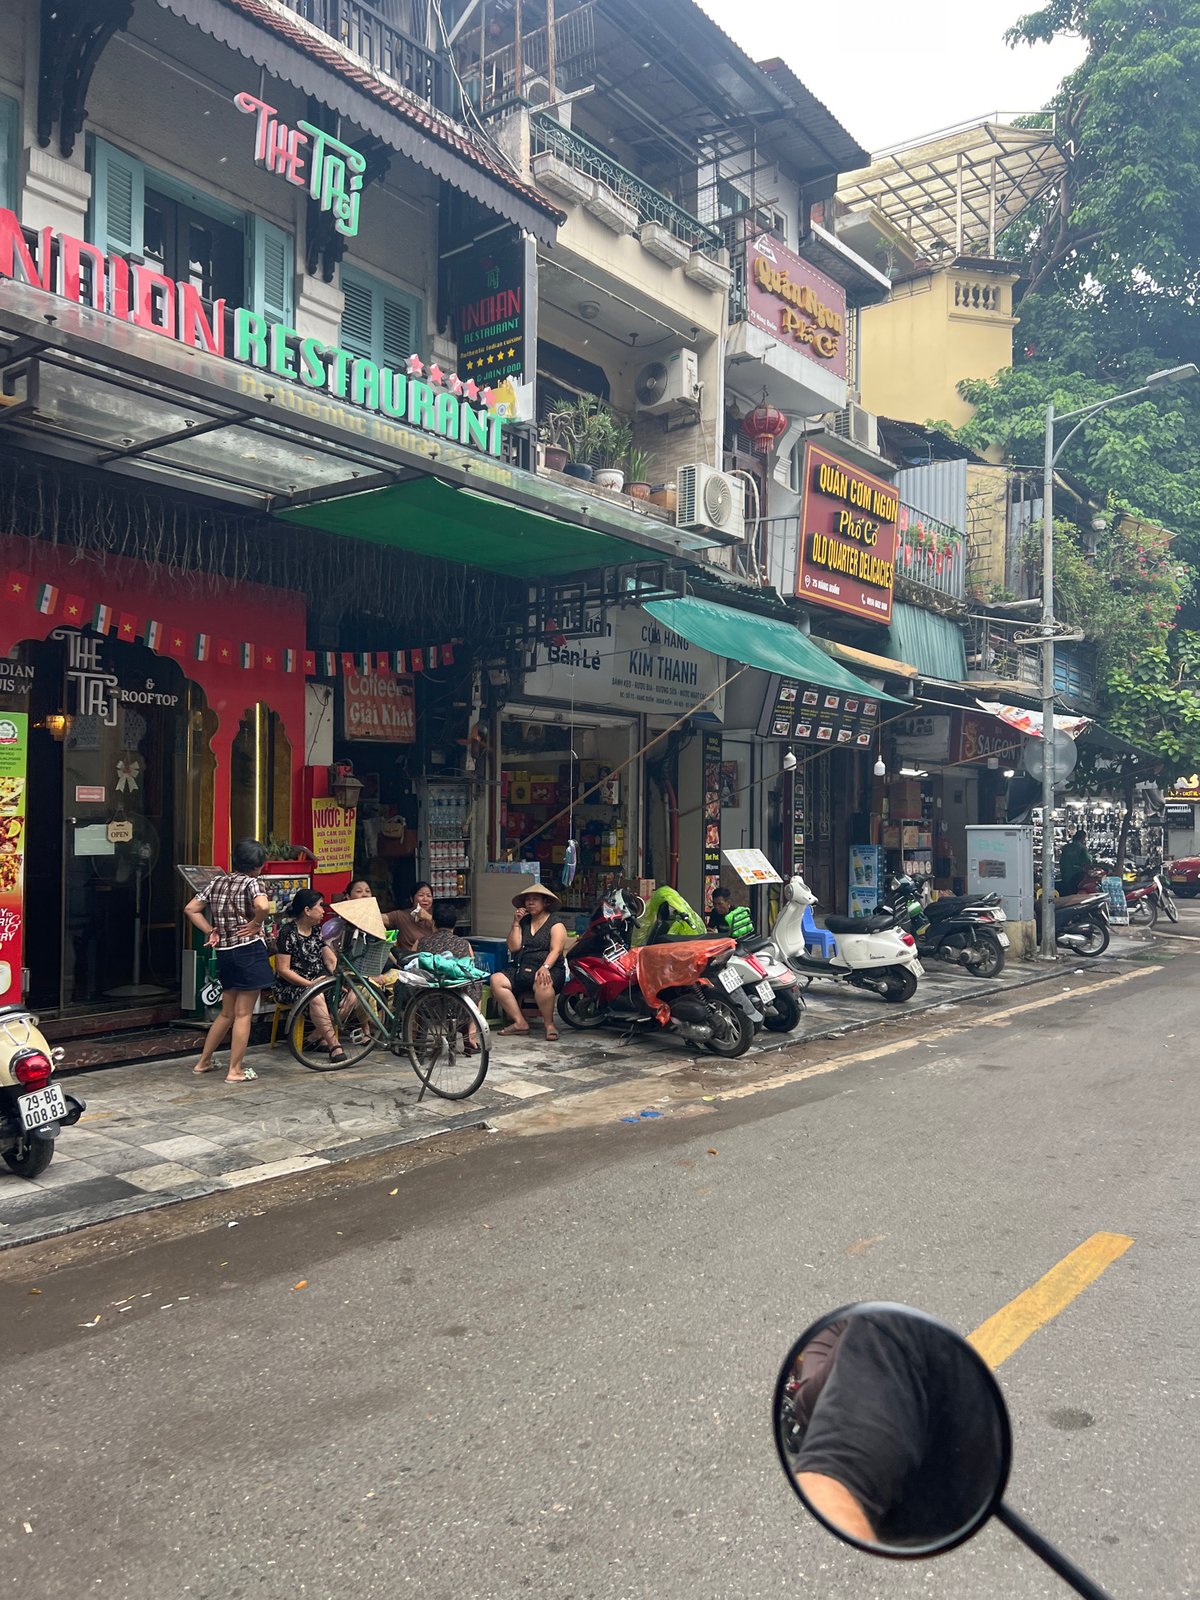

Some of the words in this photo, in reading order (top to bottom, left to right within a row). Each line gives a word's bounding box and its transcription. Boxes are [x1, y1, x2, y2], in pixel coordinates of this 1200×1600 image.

[234, 92, 308, 186] THE
[461, 287, 521, 332] INDIAN
[464, 317, 519, 344] RESTAURANT
[234, 308, 502, 457] RESTAURANT
[502, 362, 522, 375] FOOD
[819, 463, 848, 499] QUÁN
[850, 478, 872, 511] CƠM
[873, 490, 899, 523] NGON
[839, 510, 864, 540] Phố
[863, 520, 880, 547] Cổ
[812, 532, 828, 566] OLD
[827, 538, 859, 576] QUARTER
[858, 551, 894, 590] DELICACIES
[52, 629, 104, 671] THE
[629, 650, 654, 677] KIM
[657, 656, 698, 686] THANH
[121, 688, 179, 707] ROOFTOP
[145, 678, 156, 690] &
[976, 734, 1016, 760] SAIGON
[314, 803, 341, 829] NƯỚC
[25, 1101, 65, 1127] 008.83
[26, 1088, 58, 1111] 29-BG
